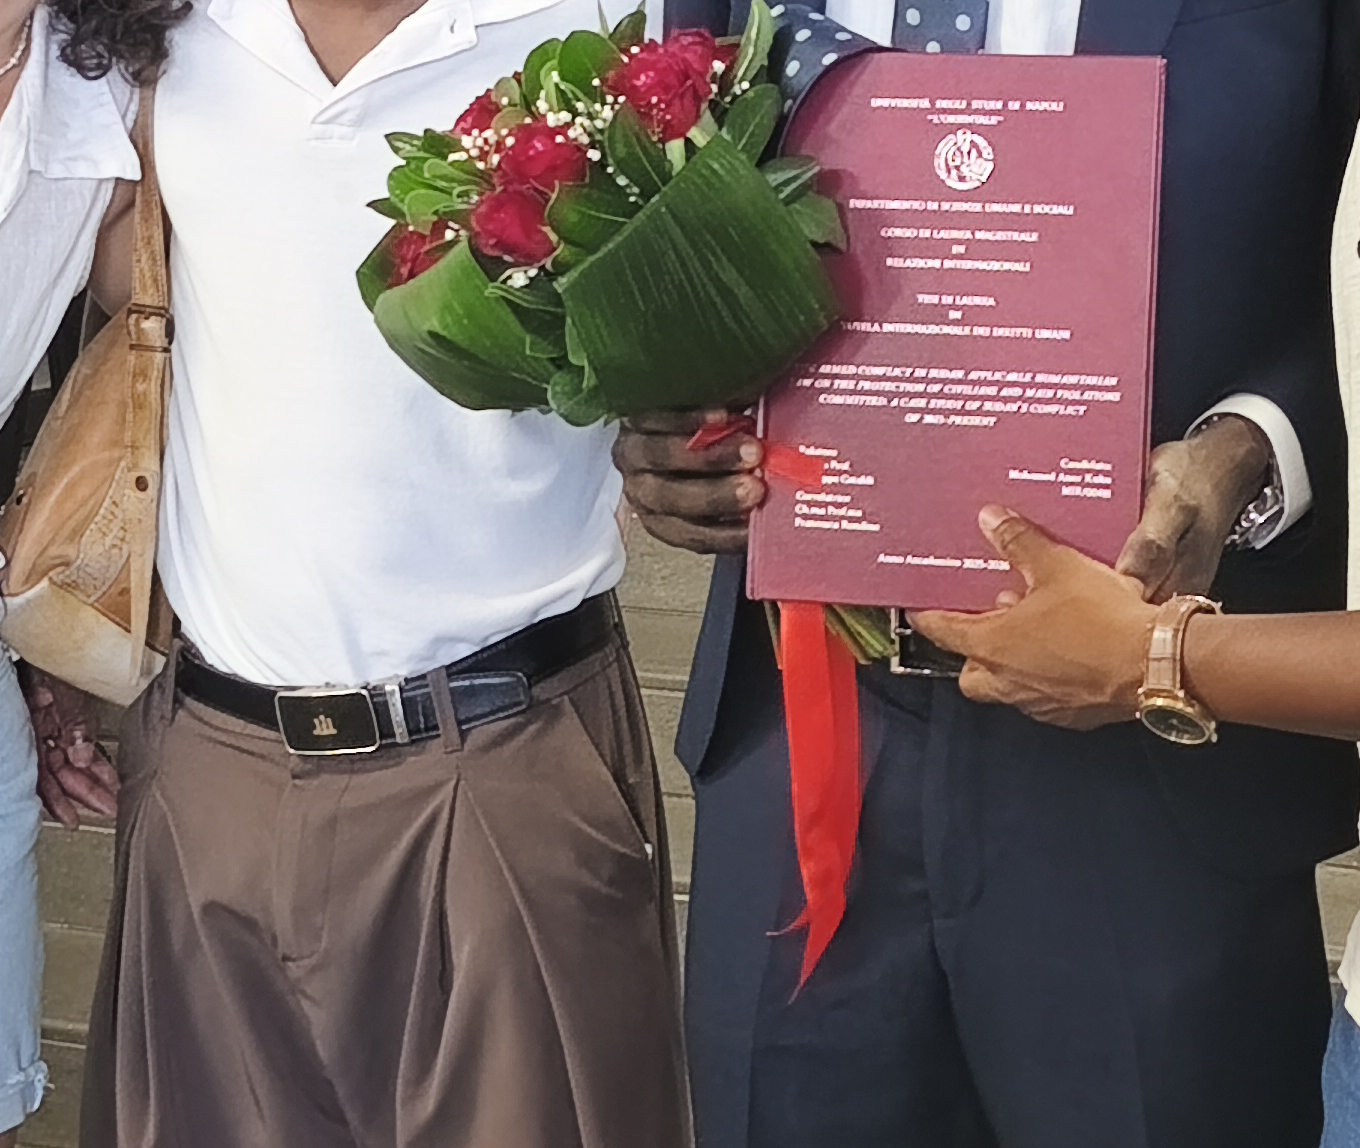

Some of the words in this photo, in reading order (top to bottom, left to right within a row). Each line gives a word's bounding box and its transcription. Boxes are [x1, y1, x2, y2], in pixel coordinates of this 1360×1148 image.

[935, 99, 967, 109] DEGLI
[971, 100, 1003, 110] STUDI
[1008, 100, 1021, 111] DI
[1025, 101, 1064, 112] NAPOLI
[849, 198, 926, 211] DIPARTIMENTO
[927, 200, 938, 211] DI
[985, 202, 1023, 214] UMANE
[1024, 204, 1031, 214] E
[1033, 204, 1074, 216] SOCIALI
[880, 227, 918, 238] CORSO
[918, 228, 931, 238] DI
[932, 229, 973, 240] LAUREA
[975, 230, 1039, 242] MAGISTRALE
[886, 257, 941, 269] RELAZIONI
[943, 259, 1031, 272] INTERNAZIONALI
[917, 293, 939, 305] TESI
[941, 295, 954, 305] DI
[955, 295, 996, 307] LAUREA
[882, 322, 971, 336] INTERNAZIONALE
[992, 327, 1033, 339] DIRITTI
[1035, 328, 1071, 340] UMANI
[857, 365, 913, 378] CONFLICT
[833, 379, 857, 390] THE
[856, 380, 927, 393] PROTECTION
[926, 383, 943, 394] OF
[1056, 389, 1122, 402] VIOLATIONS
[899, 397, 928, 408] CASE
[928, 398, 964, 410] STUDY
[964, 400, 982, 411] OF
[1029, 403, 1087, 416] CONFLICT
[877, 553, 905, 564] Anno
[905, 554, 962, 567] Accademico
